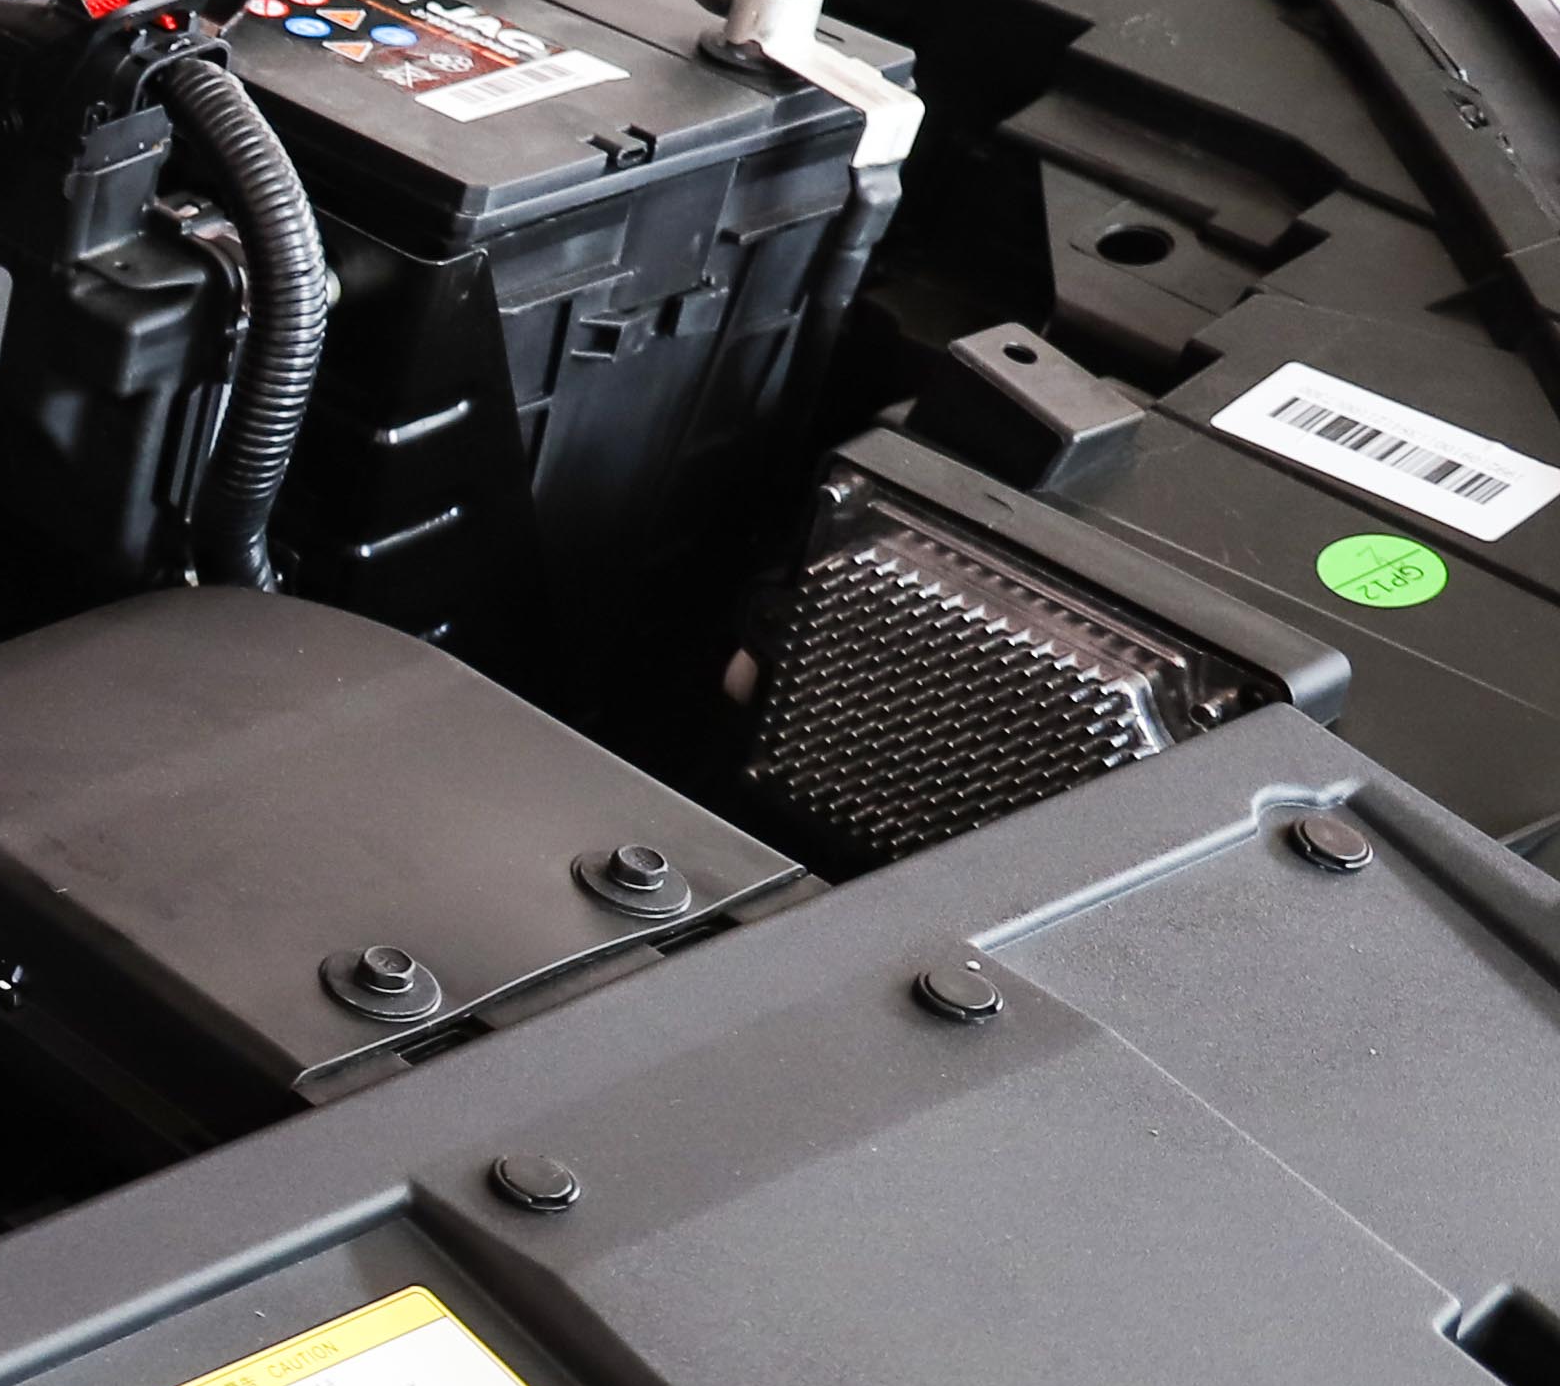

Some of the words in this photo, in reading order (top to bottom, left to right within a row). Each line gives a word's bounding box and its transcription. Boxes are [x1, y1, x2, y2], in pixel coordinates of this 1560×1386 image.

[426, 1, 548, 54] JAC
[1356, 564, 1425, 601] GP12
[266, 1341, 339, 1380] CAUTION
